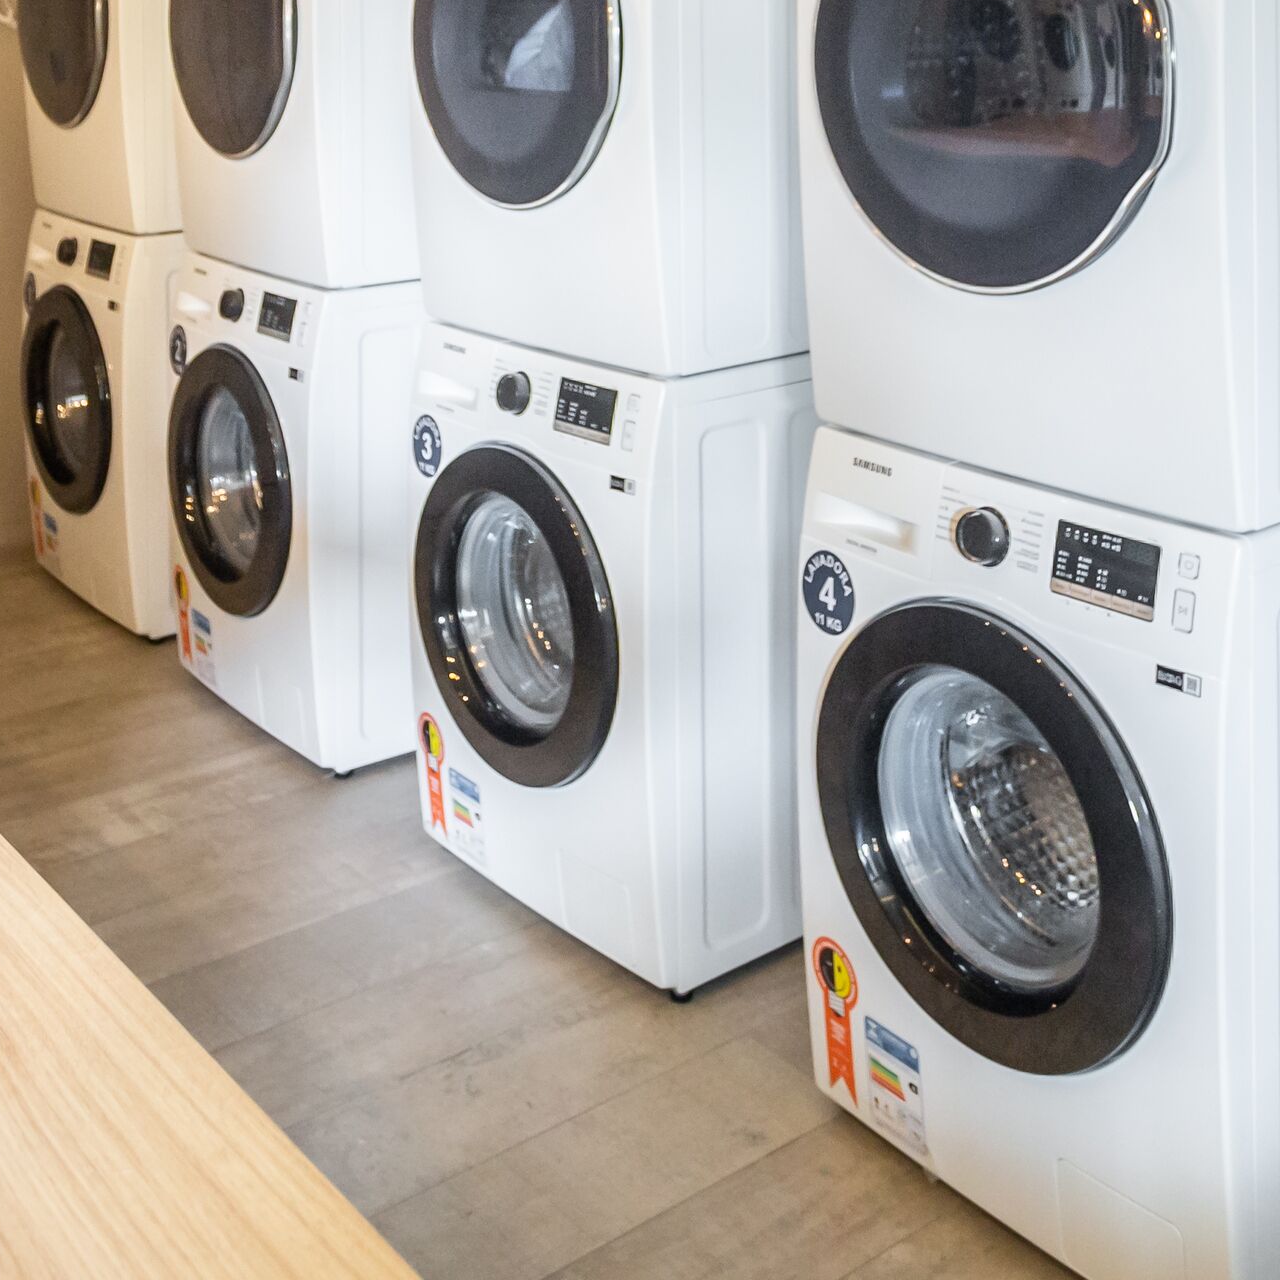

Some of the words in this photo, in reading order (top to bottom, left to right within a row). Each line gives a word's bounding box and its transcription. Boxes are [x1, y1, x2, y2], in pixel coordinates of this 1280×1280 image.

[421, 432, 433, 460] 3
[804, 554, 852, 597] LAVADORA
[819, 576, 837, 612] 4
